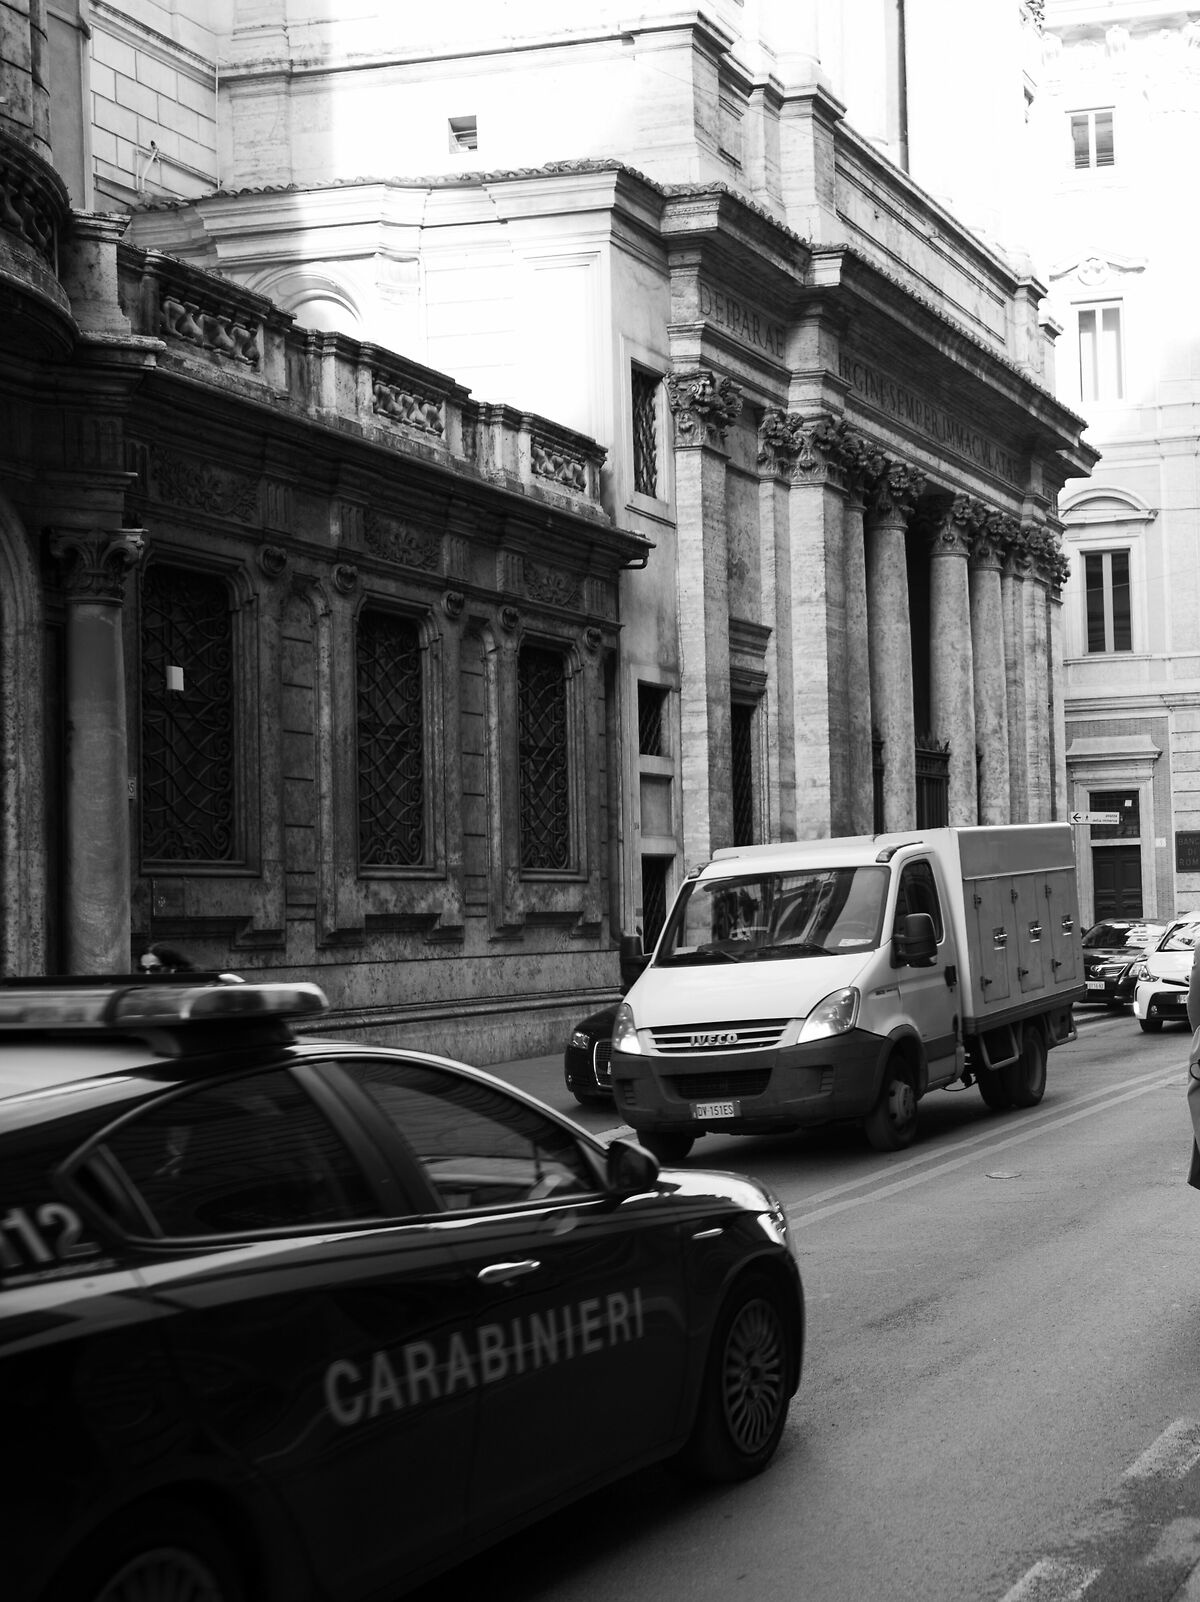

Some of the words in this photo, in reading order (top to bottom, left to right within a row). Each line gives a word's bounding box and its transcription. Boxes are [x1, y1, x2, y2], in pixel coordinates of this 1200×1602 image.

[699, 282, 786, 360] DEIPARAE
[1187, 848, 1197, 856] DI
[690, 1032, 739, 1047] IVECO
[325, 1287, 645, 1427] CARABINIERI
